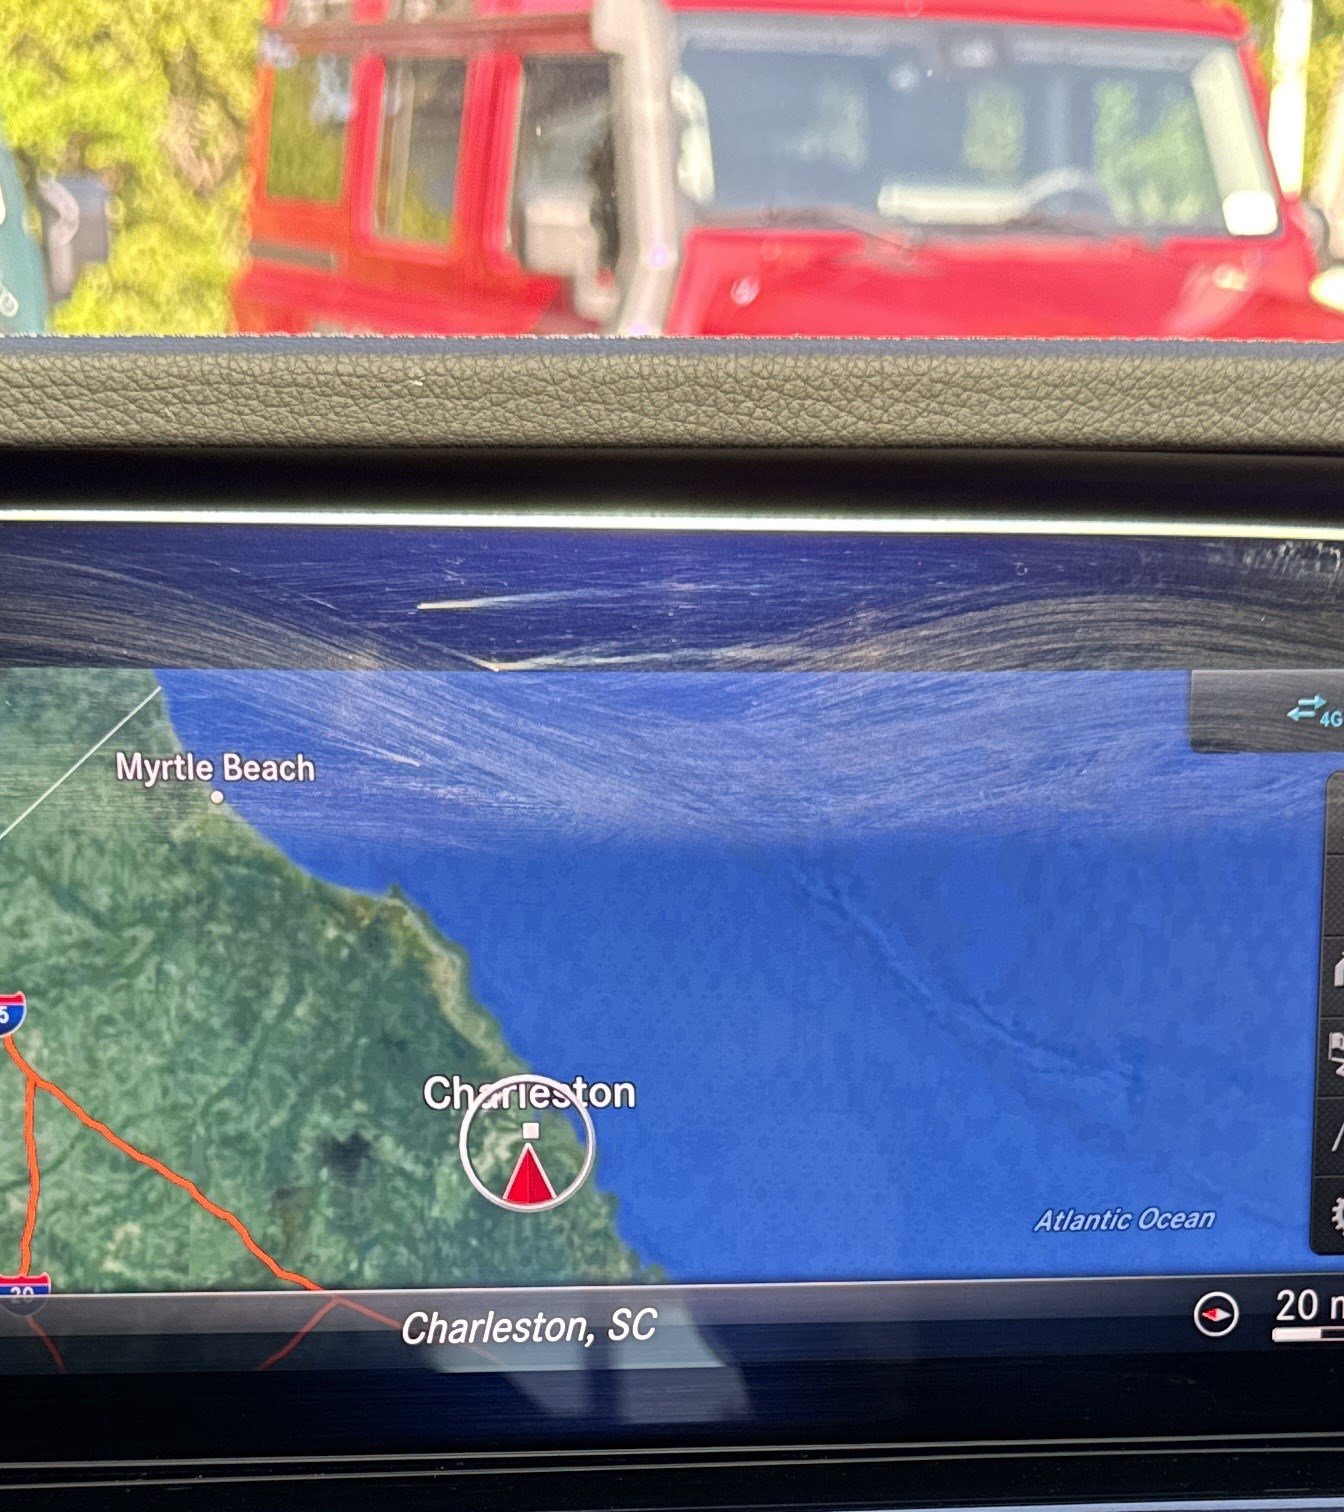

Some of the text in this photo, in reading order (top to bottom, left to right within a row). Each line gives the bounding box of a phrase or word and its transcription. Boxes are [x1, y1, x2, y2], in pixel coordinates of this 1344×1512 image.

[1319, 711, 1343, 728] 4G
[116, 753, 316, 787] Myrtle Beach
[423, 1074, 636, 1110] Charleston
[1034, 1208, 1217, 1233] Atlantic Ocean
[9, 1284, 37, 1306] 20
[1275, 1289, 1318, 1321] 20
[402, 1307, 658, 1348] Charleston, SC
